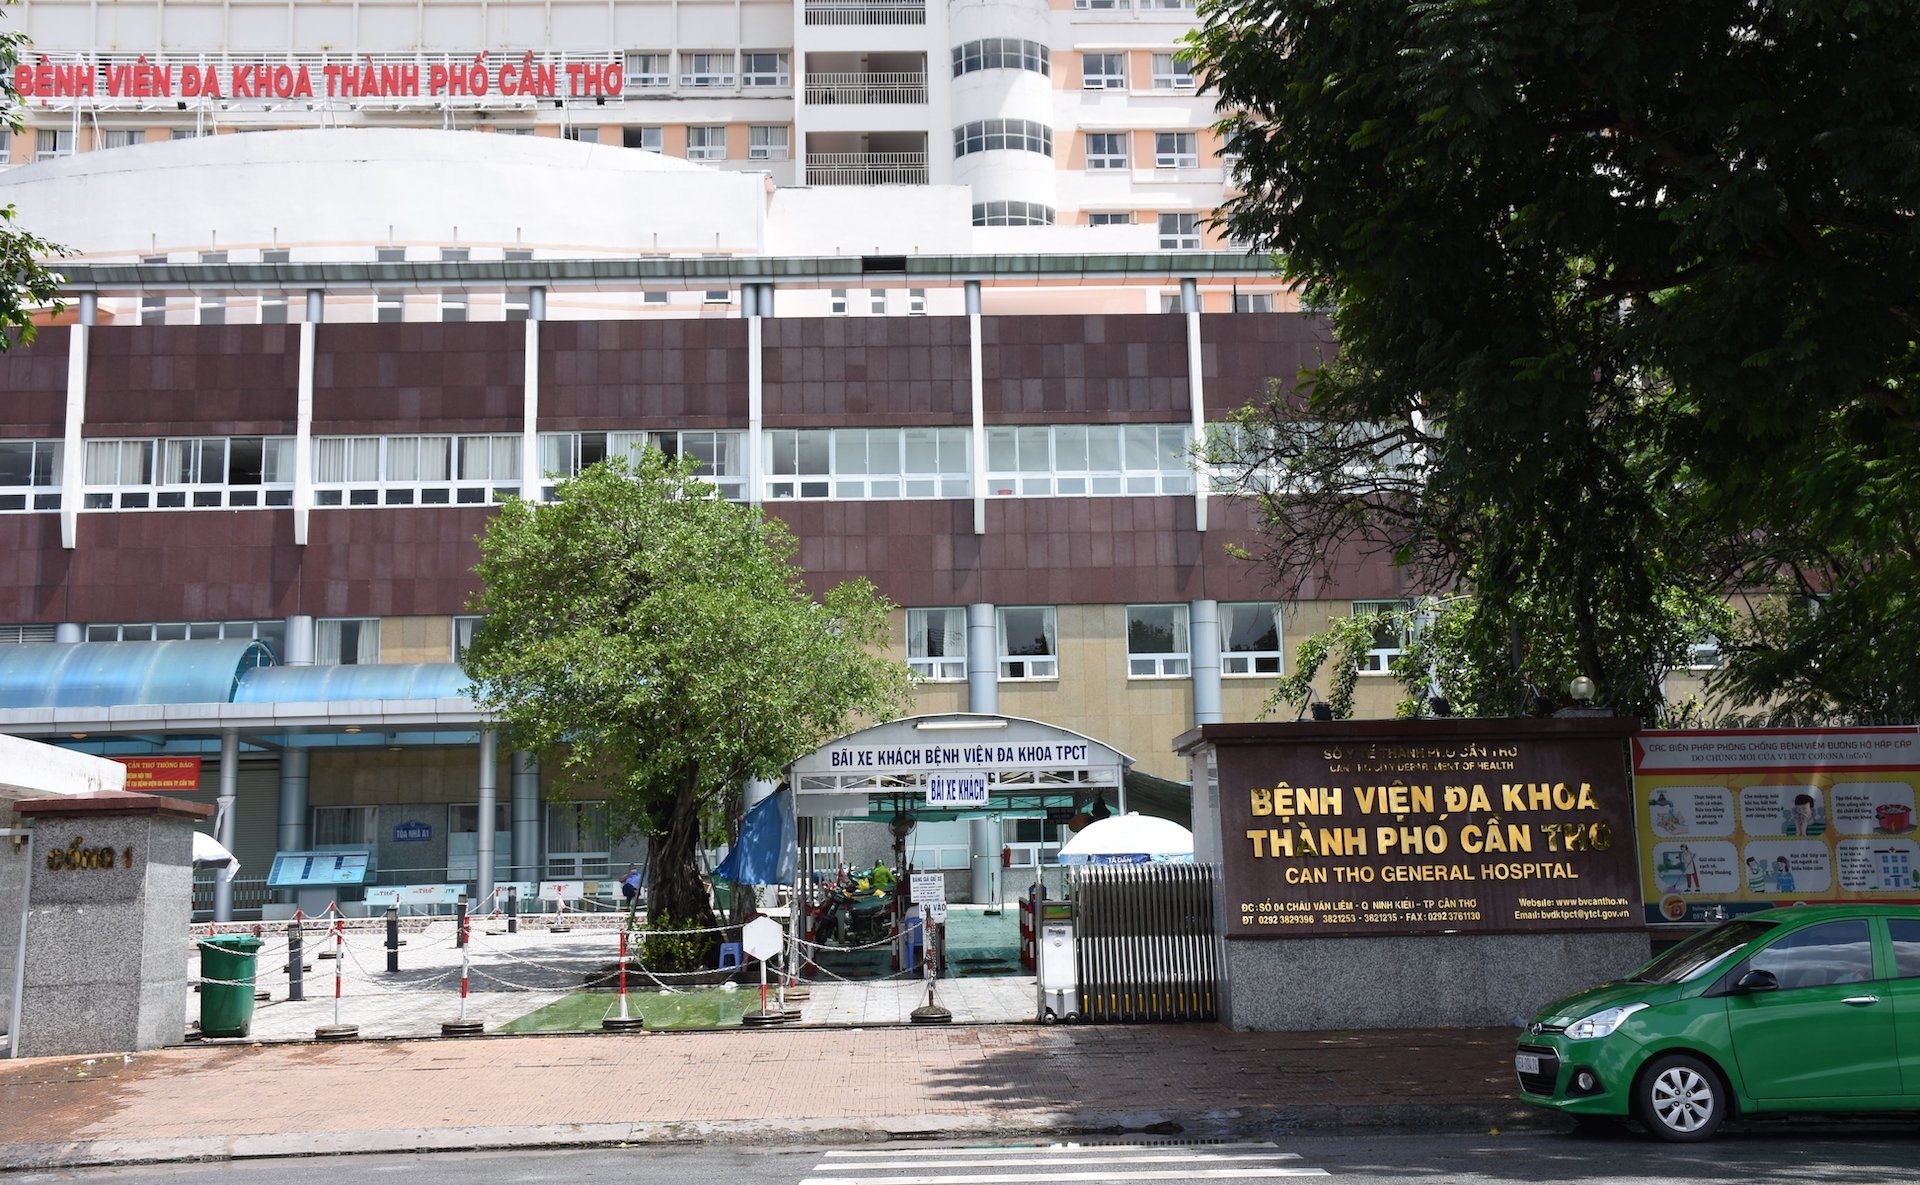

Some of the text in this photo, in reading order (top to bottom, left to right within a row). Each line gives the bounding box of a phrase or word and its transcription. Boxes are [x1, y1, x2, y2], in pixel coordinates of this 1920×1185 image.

[14, 54, 95, 106] BỆNH
[105, 54, 171, 103] VIỆN
[181, 64, 222, 97] ĐA
[233, 64, 314, 98] KHOA
[324, 53, 419, 97] THÀNH
[430, 50, 489, 97] PHỐ
[566, 63, 624, 97] THƠ
[832, 745, 1087, 767] BÃI XE KHÁCH BỆNH VIỆN ĐA KHOA TPCT
[1477, 761, 1514, 771] HEALTH
[1808, 752, 1844, 760] CORONA
[931, 774, 984, 801] BÃI XE KHÁCH
[1251, 779, 1599, 824] BỆNH VIỆN ĐA KHOA
[1246, 821, 1368, 858] THÀNH
[1460, 812, 1532, 854] CẦN
[1285, 862, 1578, 885] CAN THO GENERAL HOSPITAL
[1273, 902, 1284, 912] 04
[1286, 899, 1311, 912] CHÂU
[1313, 899, 1331, 911] VĂN
[1373, 901, 1393, 911] NINH
[1423, 899, 1435, 909] TP
[1258, 915, 1278, 925] 0292
[1279, 915, 1315, 925] 3829396
[1322, 914, 1356, 924] 3821253
[1364, 913, 1398, 923] 3821235
[1427, 911, 1447, 921] 0292
[1448, 911, 1481, 921] 3761130
